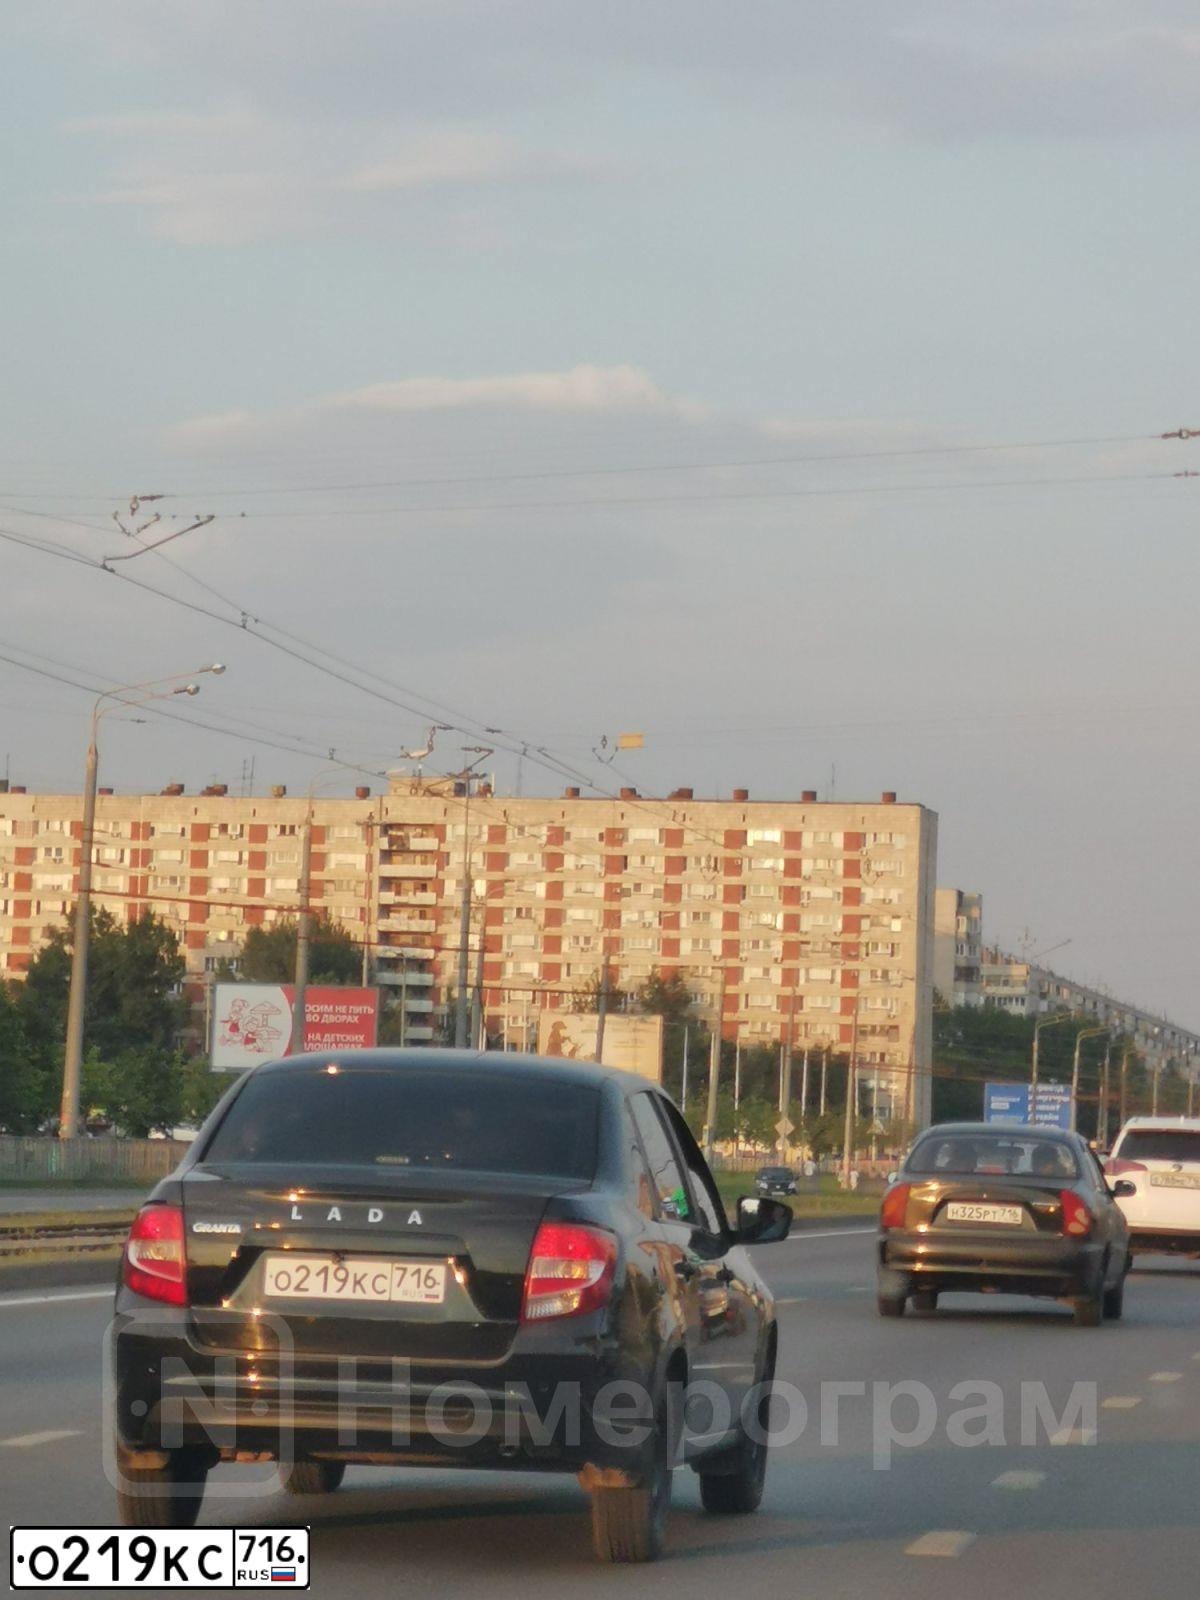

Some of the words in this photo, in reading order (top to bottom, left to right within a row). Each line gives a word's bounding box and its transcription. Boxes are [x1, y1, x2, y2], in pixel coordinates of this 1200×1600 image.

[291, 1003, 333, 1013] ОСИМ
[335, 1005, 347, 1014] НЕ
[348, 1005, 375, 1015] ПИТЬ
[320, 1013, 360, 1024] ДВОРАХ
[307, 1032, 321, 1041] НА
[322, 1032, 365, 1043] ДЕТСКИХ
[291, 1206, 422, 1225] LADA
[394, 1266, 437, 1289] 716
